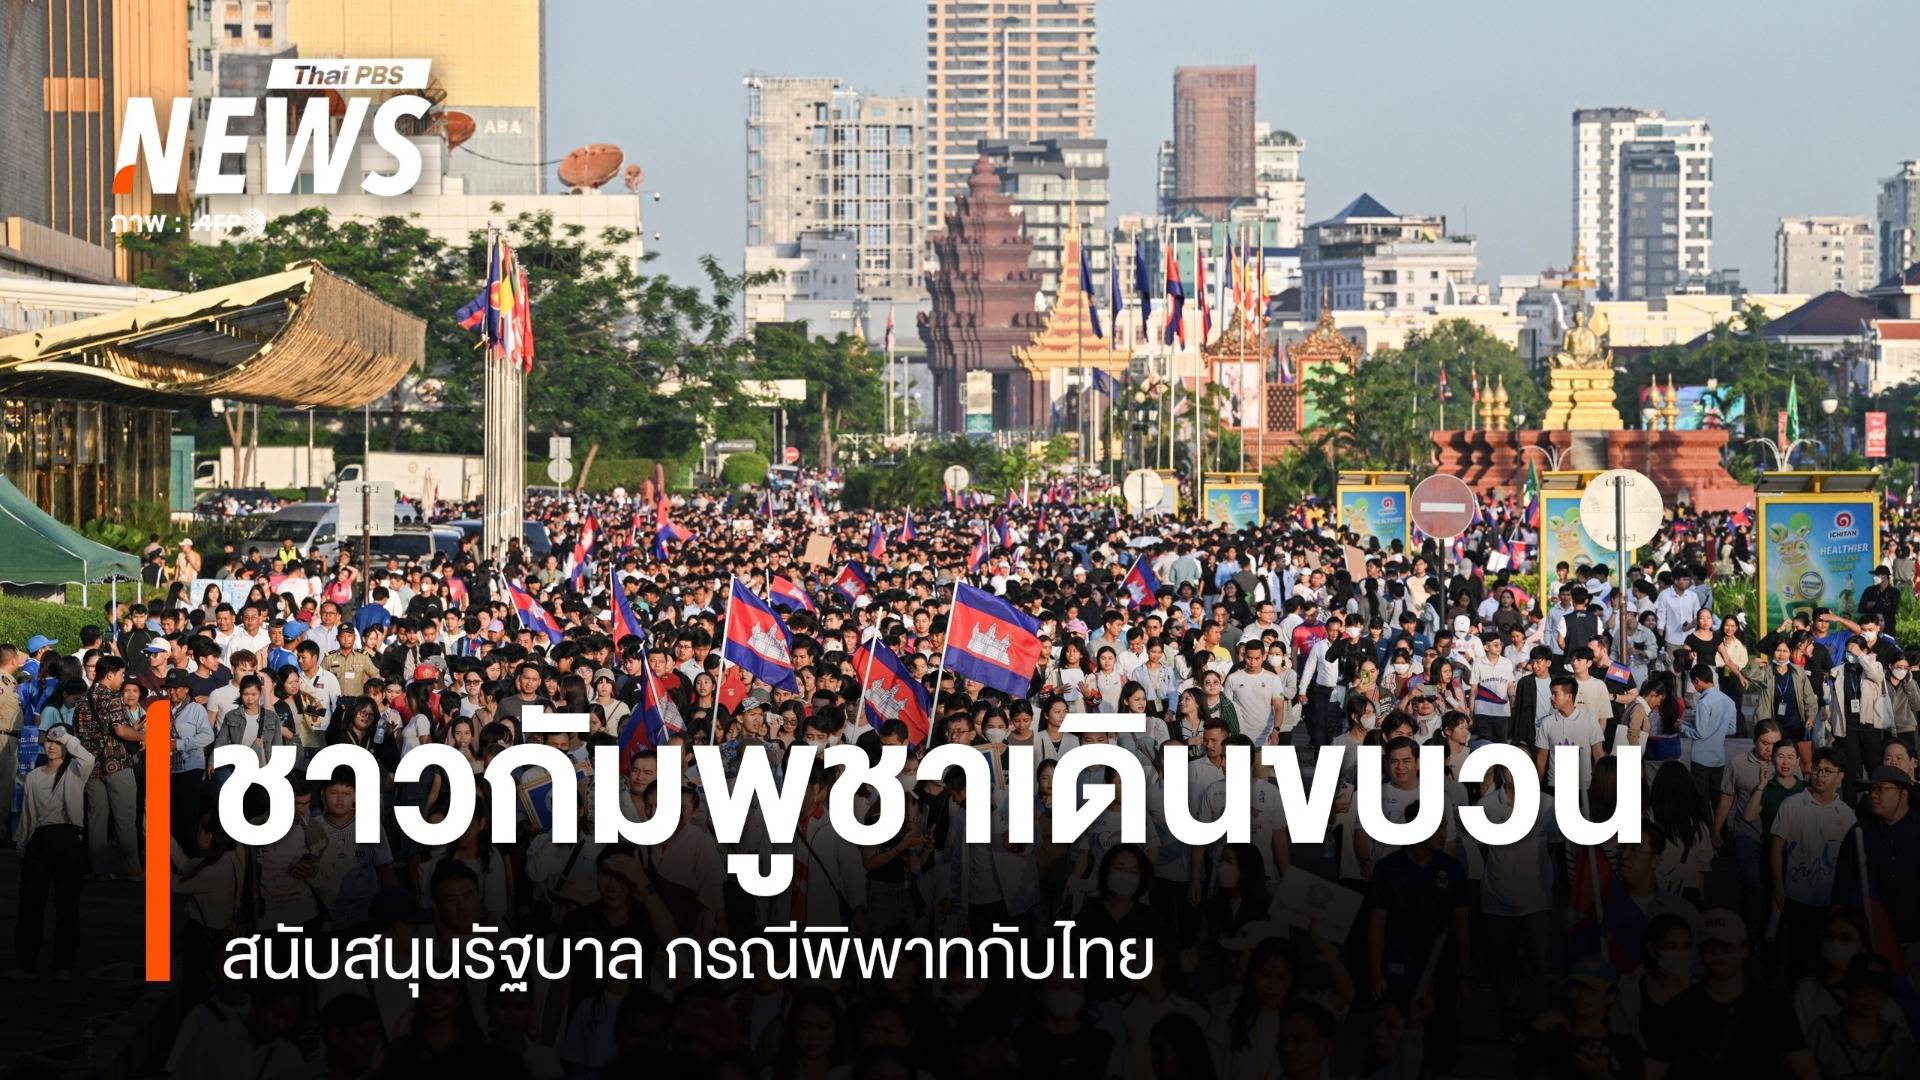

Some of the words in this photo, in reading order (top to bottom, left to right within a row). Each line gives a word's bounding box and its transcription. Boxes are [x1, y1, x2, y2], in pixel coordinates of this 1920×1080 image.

[484, 119, 523, 135] ABA
[1829, 530, 1857, 538] ICHITAN
[1820, 543, 1869, 555] HEALTHIER
